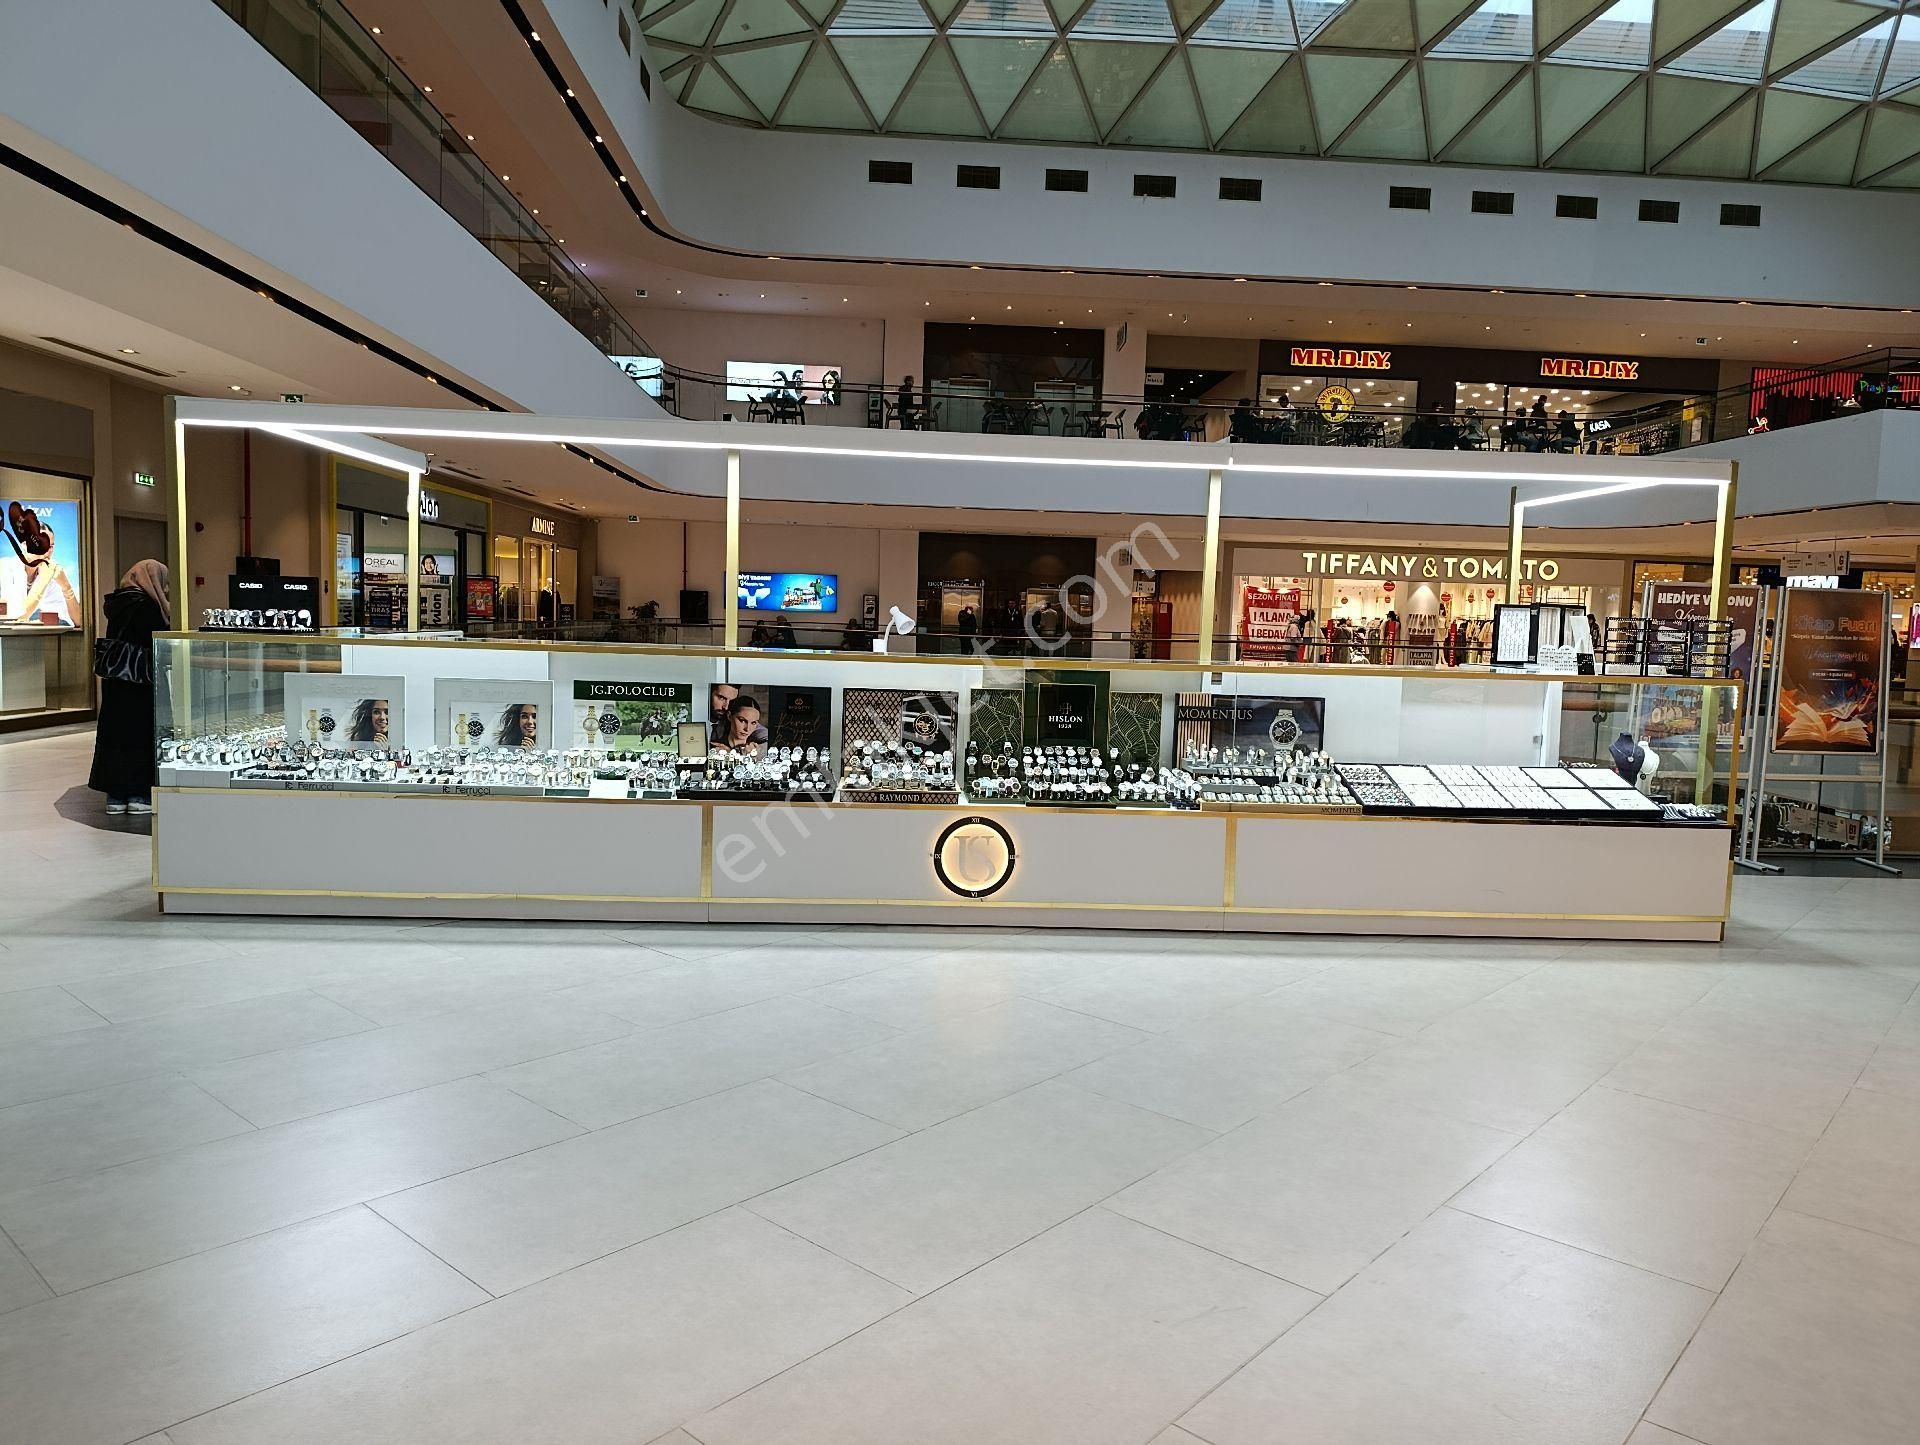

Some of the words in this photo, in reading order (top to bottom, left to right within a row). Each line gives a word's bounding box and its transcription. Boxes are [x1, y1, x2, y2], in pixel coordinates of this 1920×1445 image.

[1589, 419, 1611, 433] KASA
[418, 490, 440, 518] ion
[1303, 552, 1418, 577] TIFFANY
[1422, 557, 1438, 578] &
[1443, 558, 1559, 581] TOMTO
[1658, 590, 1700, 605] HEDİYE
[1702, 594, 1754, 608] VONU
[1257, 629, 1287, 639] BEDAV
[1178, 709, 1253, 720] MOMENTUS
[298, 782, 334, 791] Ferrucci
[456, 786, 490, 796] Ferrucci
[880, 793, 919, 802] RAYMOND
